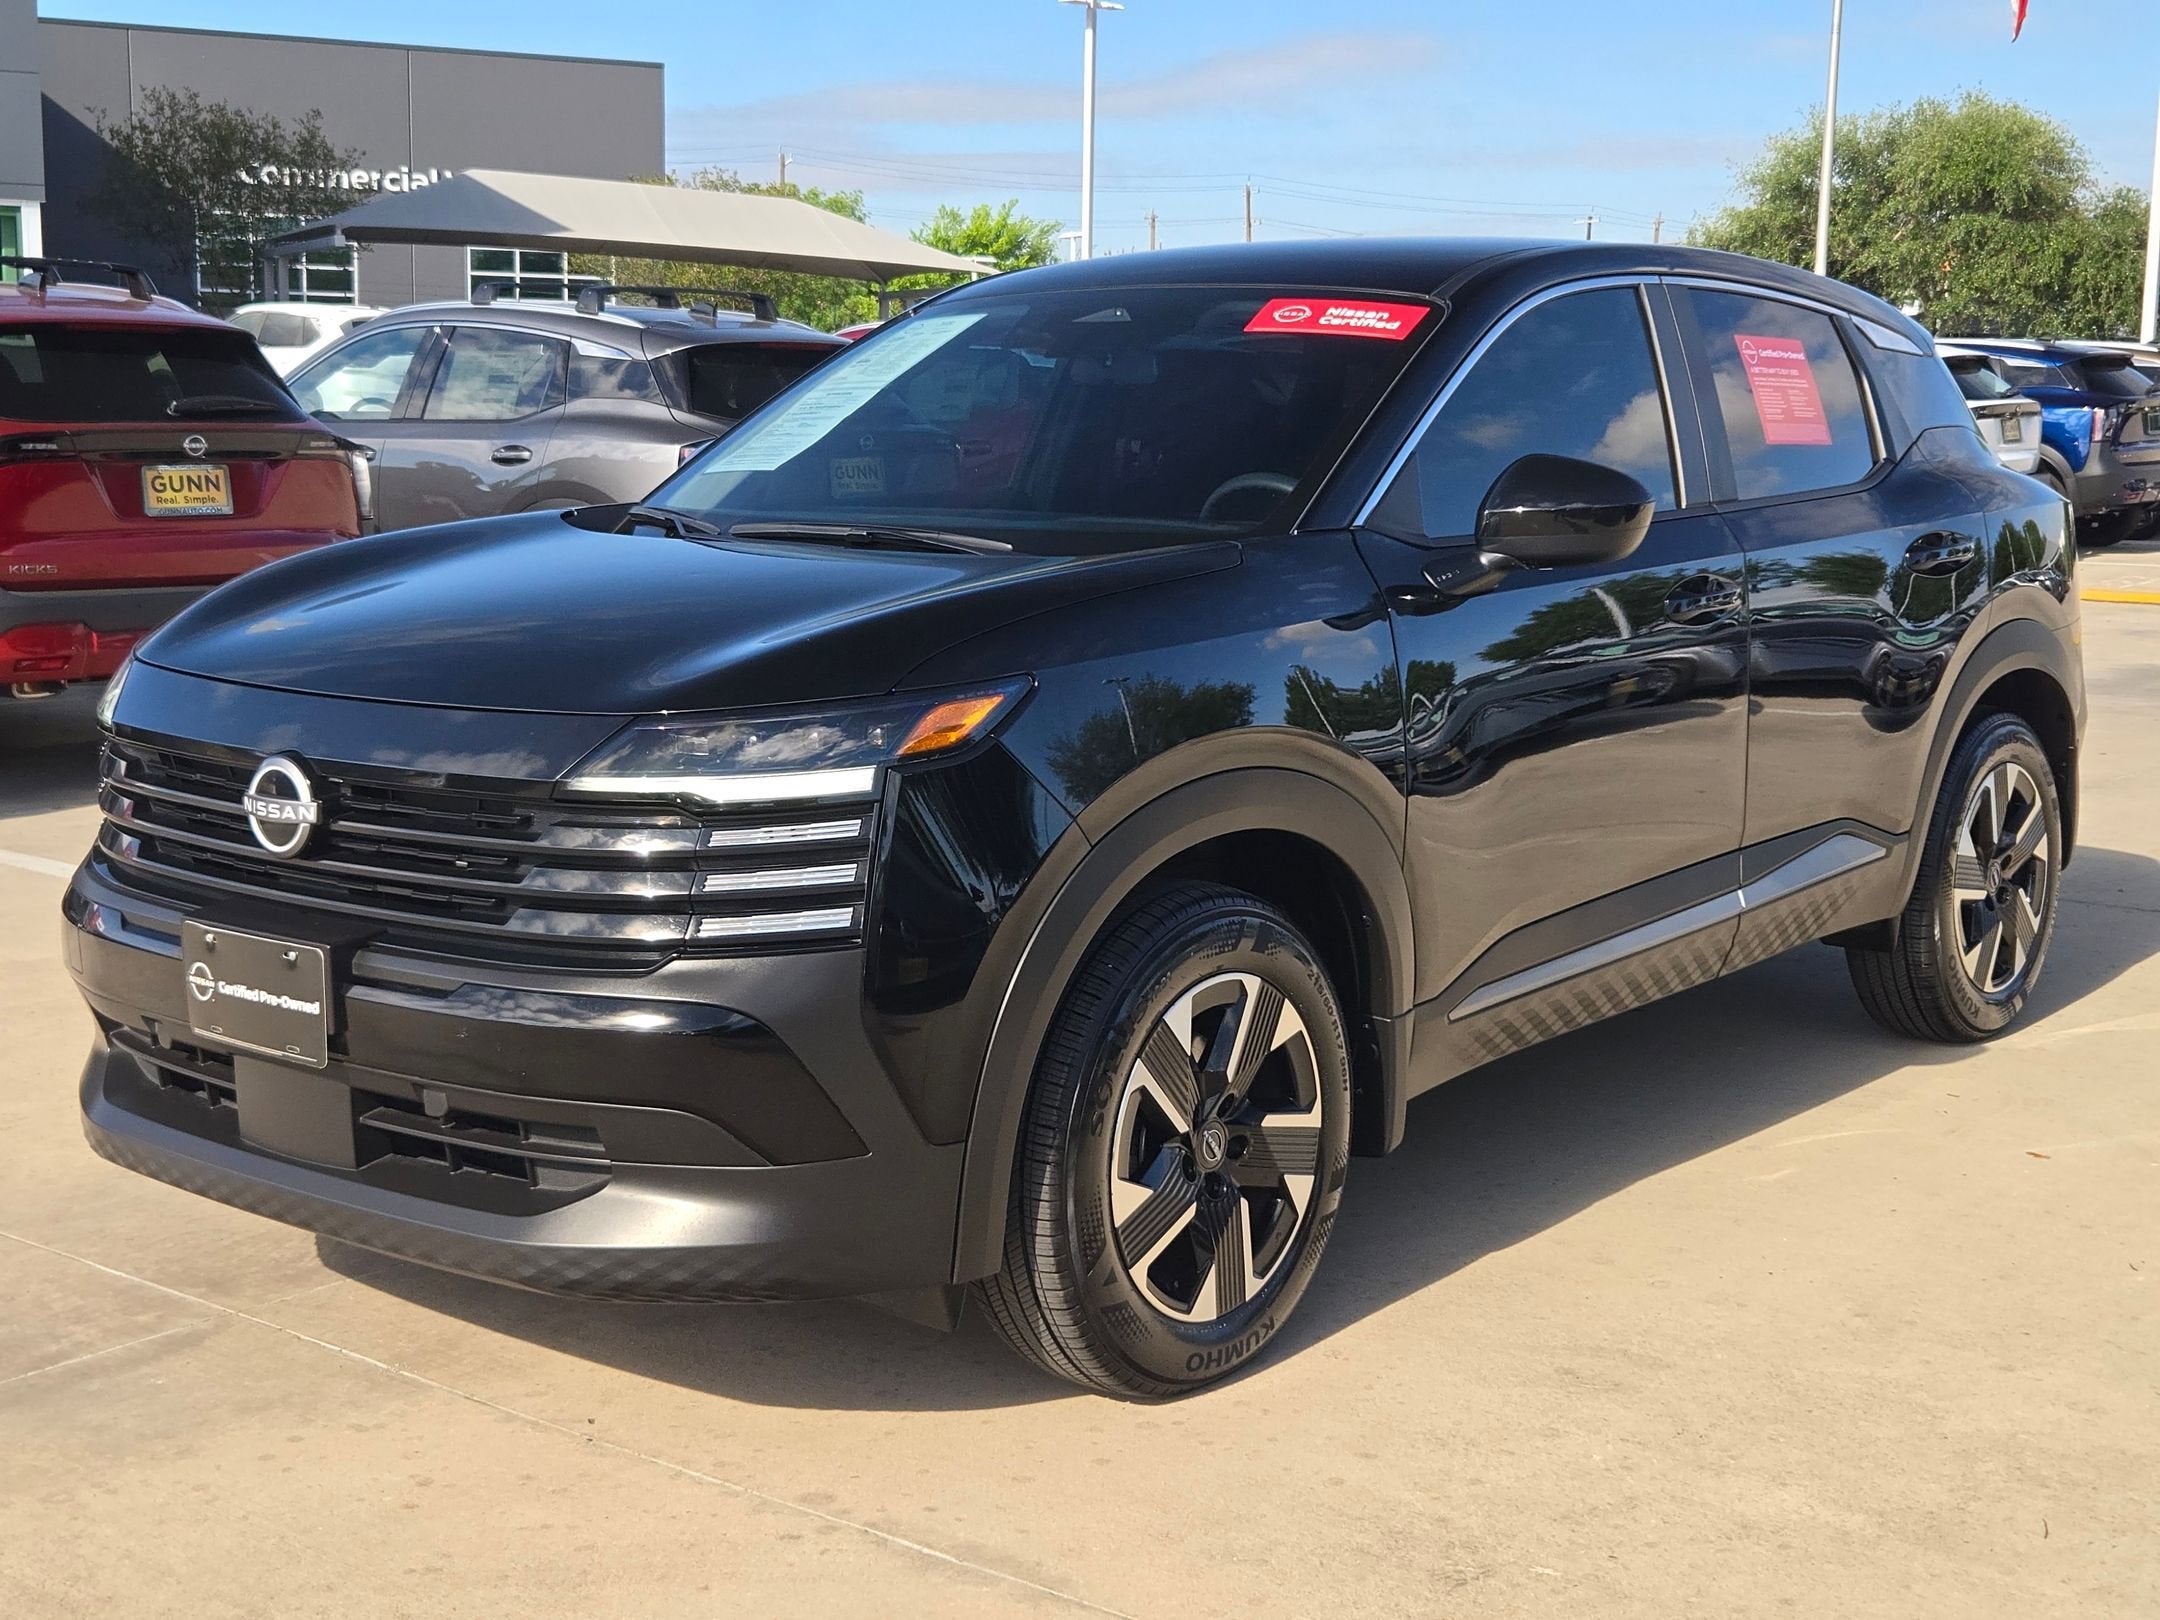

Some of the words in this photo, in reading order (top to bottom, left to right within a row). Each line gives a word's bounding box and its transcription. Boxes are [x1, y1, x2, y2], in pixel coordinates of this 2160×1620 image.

[1325, 306, 1389, 319] Nissan
[1318, 316, 1402, 330] Certified
[150, 474, 221, 493] GUNN
[156, 496, 180, 505] Real.
[183, 495, 219, 505] Simple.
[8, 564, 59, 575] KICKS
[243, 796, 315, 821] NISSAN
[217, 980, 259, 1002] Certified
[259, 990, 320, 1016] Pre-Owned
[1185, 1314, 1275, 1372] KUMHO
